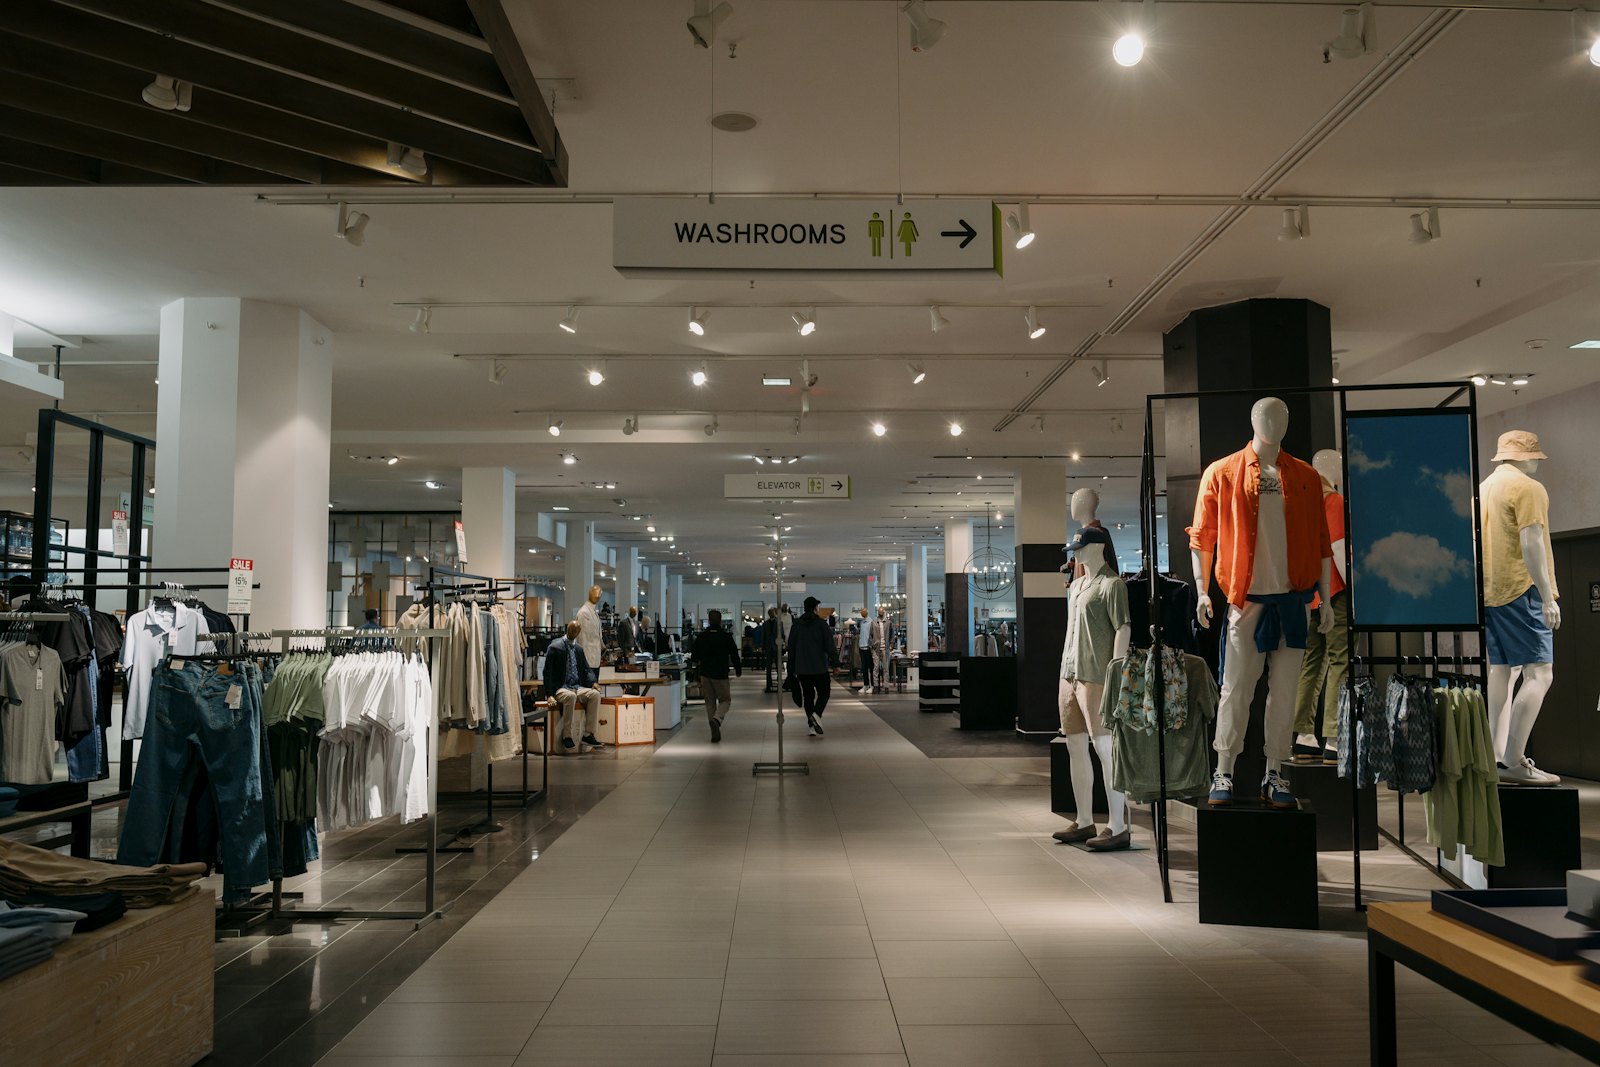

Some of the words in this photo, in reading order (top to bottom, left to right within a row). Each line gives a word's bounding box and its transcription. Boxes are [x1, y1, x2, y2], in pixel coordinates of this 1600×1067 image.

[674, 222, 846, 245] WASHROOMS
[757, 481, 801, 490] ELEVATOR
[113, 511, 125, 520] SALE
[232, 559, 250, 569] SALE
[235, 576, 247, 585] 15%
